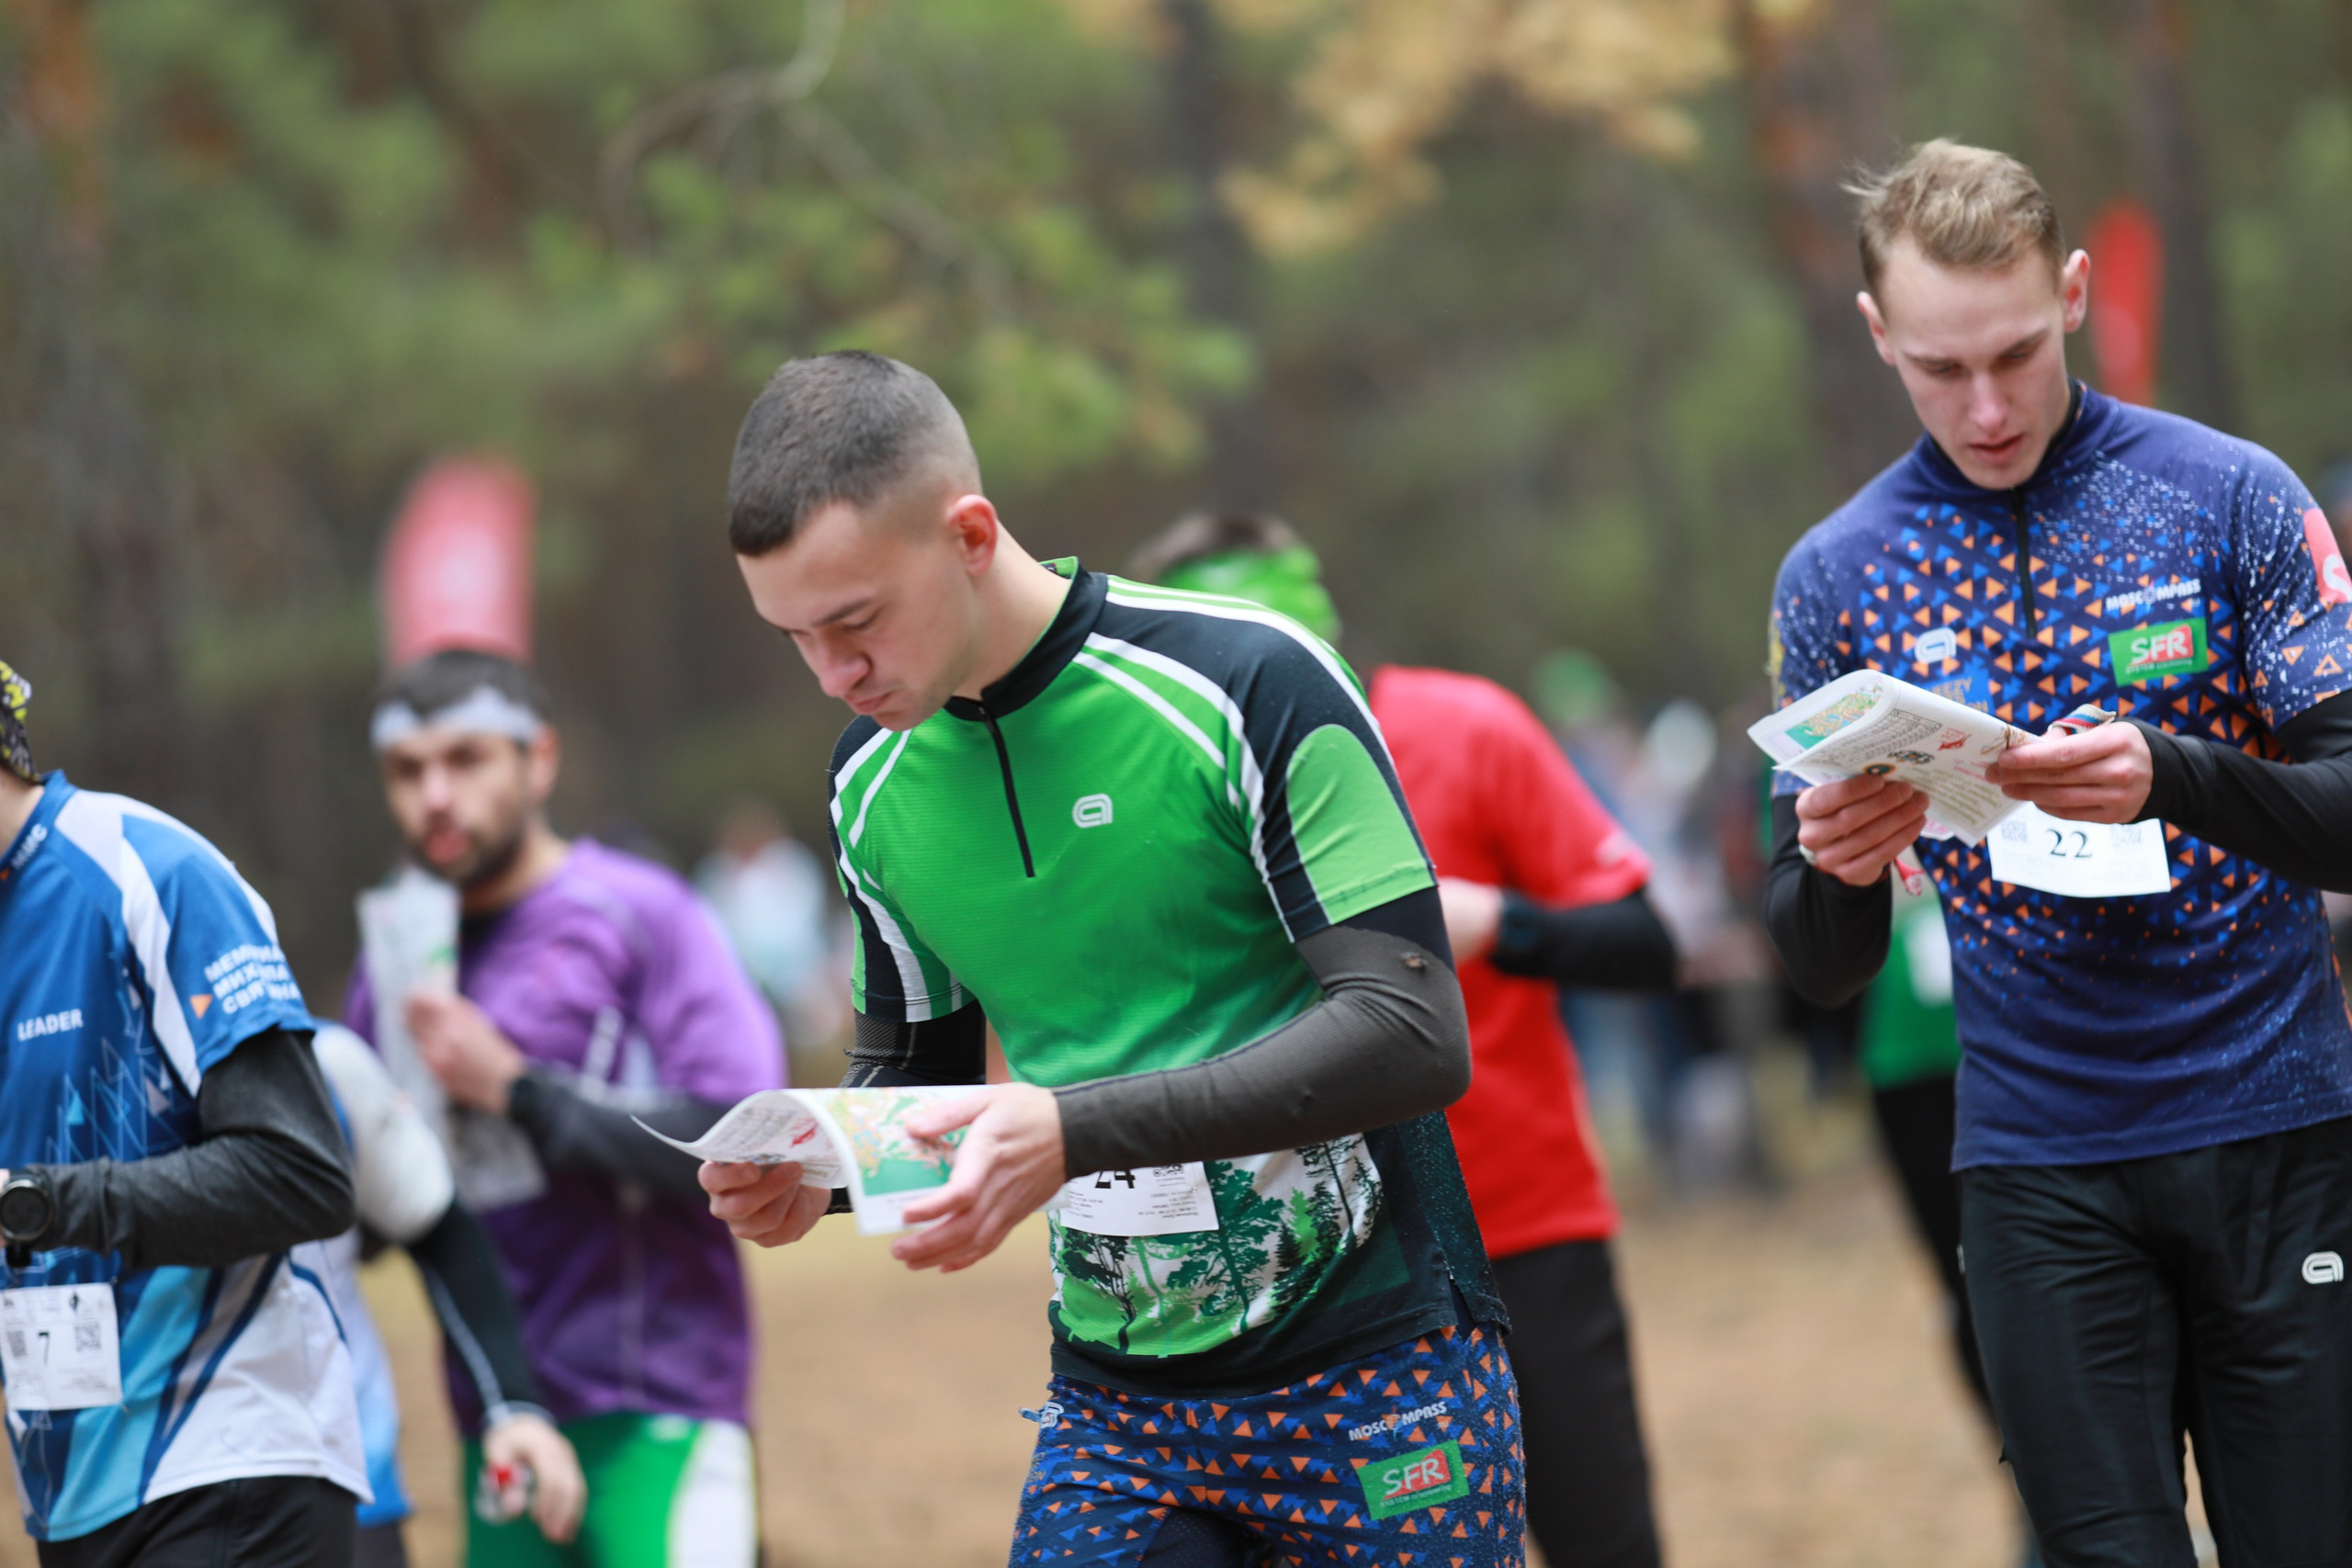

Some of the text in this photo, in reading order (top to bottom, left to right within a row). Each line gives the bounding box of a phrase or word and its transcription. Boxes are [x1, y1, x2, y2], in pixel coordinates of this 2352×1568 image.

[2130, 630, 2188, 665] SFR
[2045, 828, 2093, 859] 22
[17, 1008, 84, 1042] LEADER
[38, 1331, 50, 1367] 7
[1383, 1458, 1444, 1495] SFR
